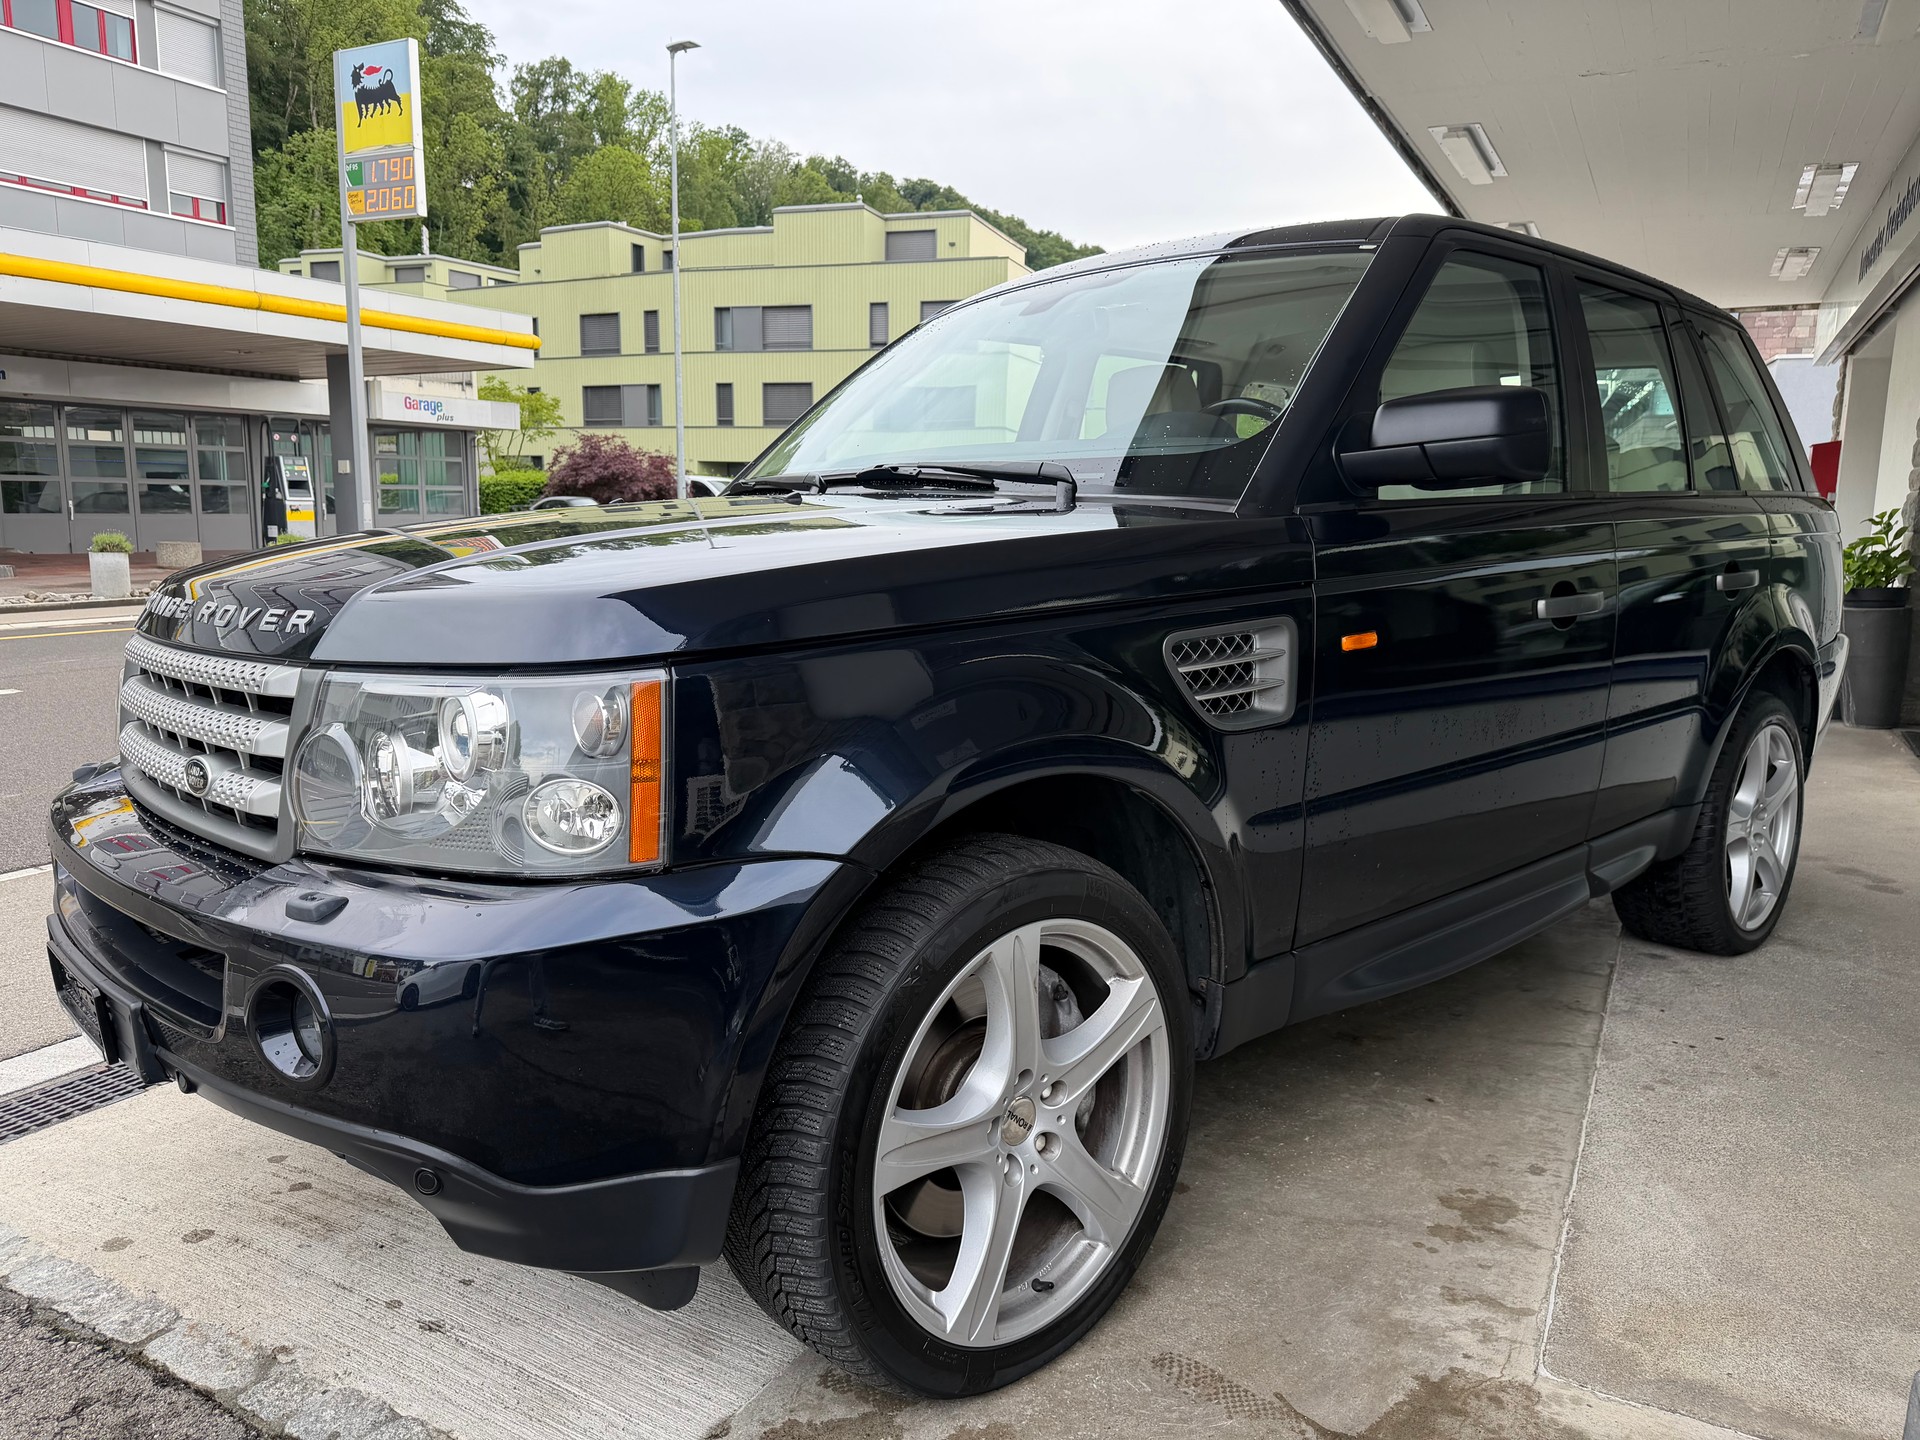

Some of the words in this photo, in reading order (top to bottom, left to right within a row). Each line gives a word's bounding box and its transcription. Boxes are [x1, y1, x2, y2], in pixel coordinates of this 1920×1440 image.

[367, 186, 414, 212] 2.060
[404, 396, 443, 416] Garage
[436, 413, 454, 422] plus
[196, 601, 316, 634] ROVER
[1007, 1110, 1028, 1130] RONAL
